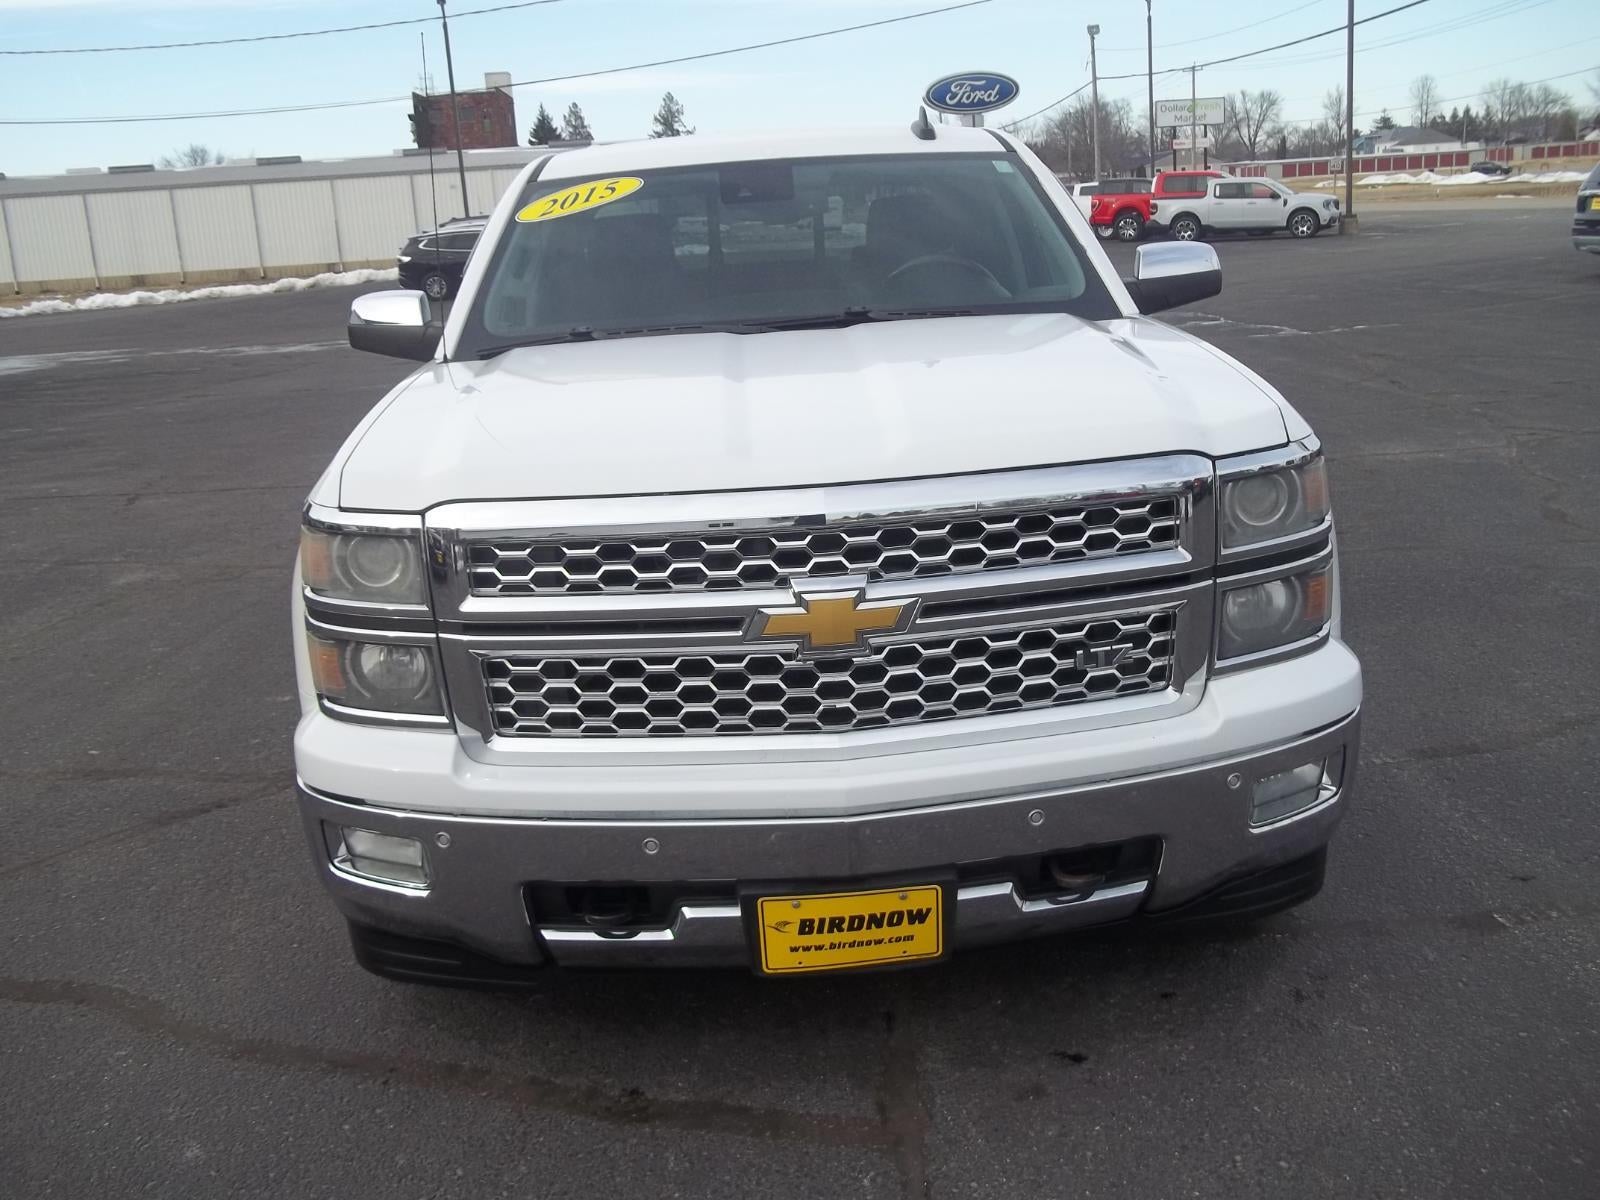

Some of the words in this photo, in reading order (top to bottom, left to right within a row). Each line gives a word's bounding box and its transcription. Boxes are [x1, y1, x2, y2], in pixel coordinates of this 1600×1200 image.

[945, 80, 1000, 105] Ford
[1160, 103, 1187, 113] Dollar
[1174, 112, 1207, 123] Maret
[538, 180, 620, 218] 2015
[1075, 642, 1134, 671] LTZ
[797, 907, 932, 936] BIRDNOW
[789, 934, 915, 953] www.birdnow.com
